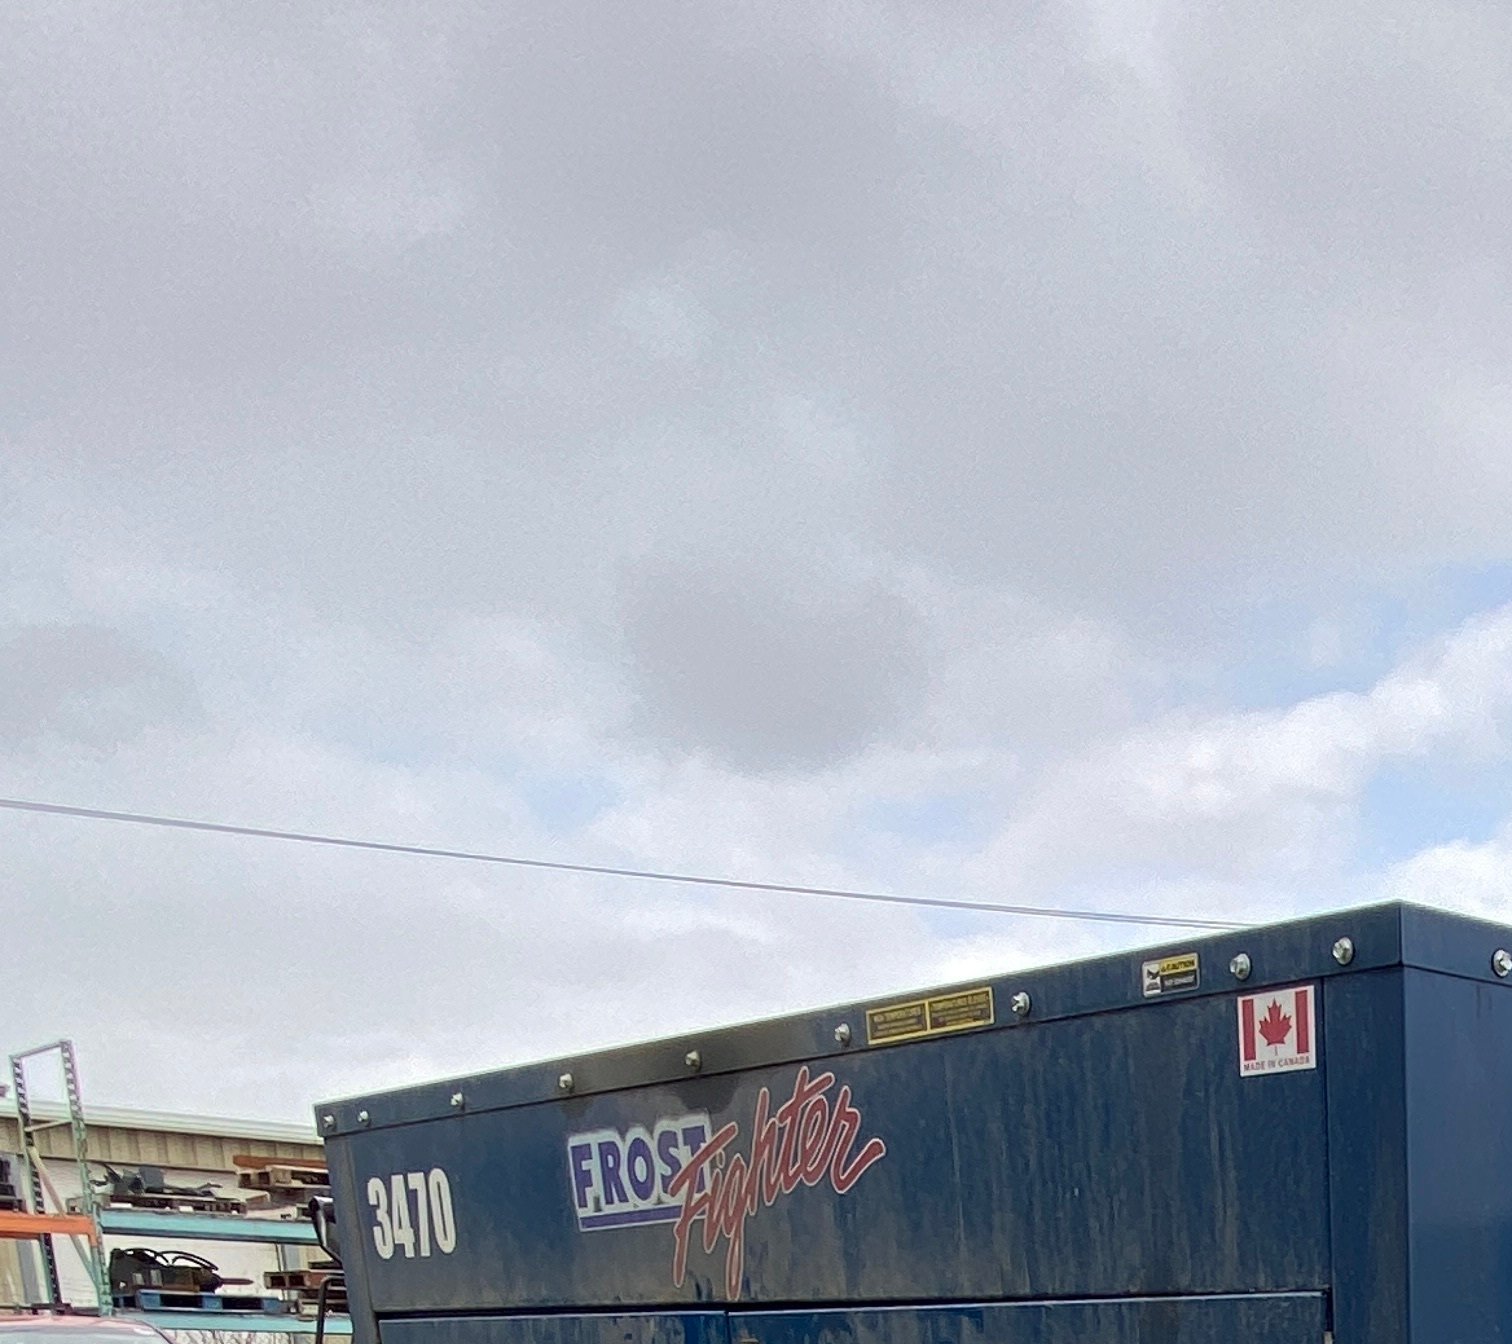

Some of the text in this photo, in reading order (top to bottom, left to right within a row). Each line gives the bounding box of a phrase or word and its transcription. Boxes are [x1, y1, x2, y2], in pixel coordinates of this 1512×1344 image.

[1243, 1055, 1310, 1072] MADE IN CANADA
[570, 1123, 708, 1210] FROST
[667, 1065, 886, 1302] Fighter
[366, 1167, 457, 1260] 3470
